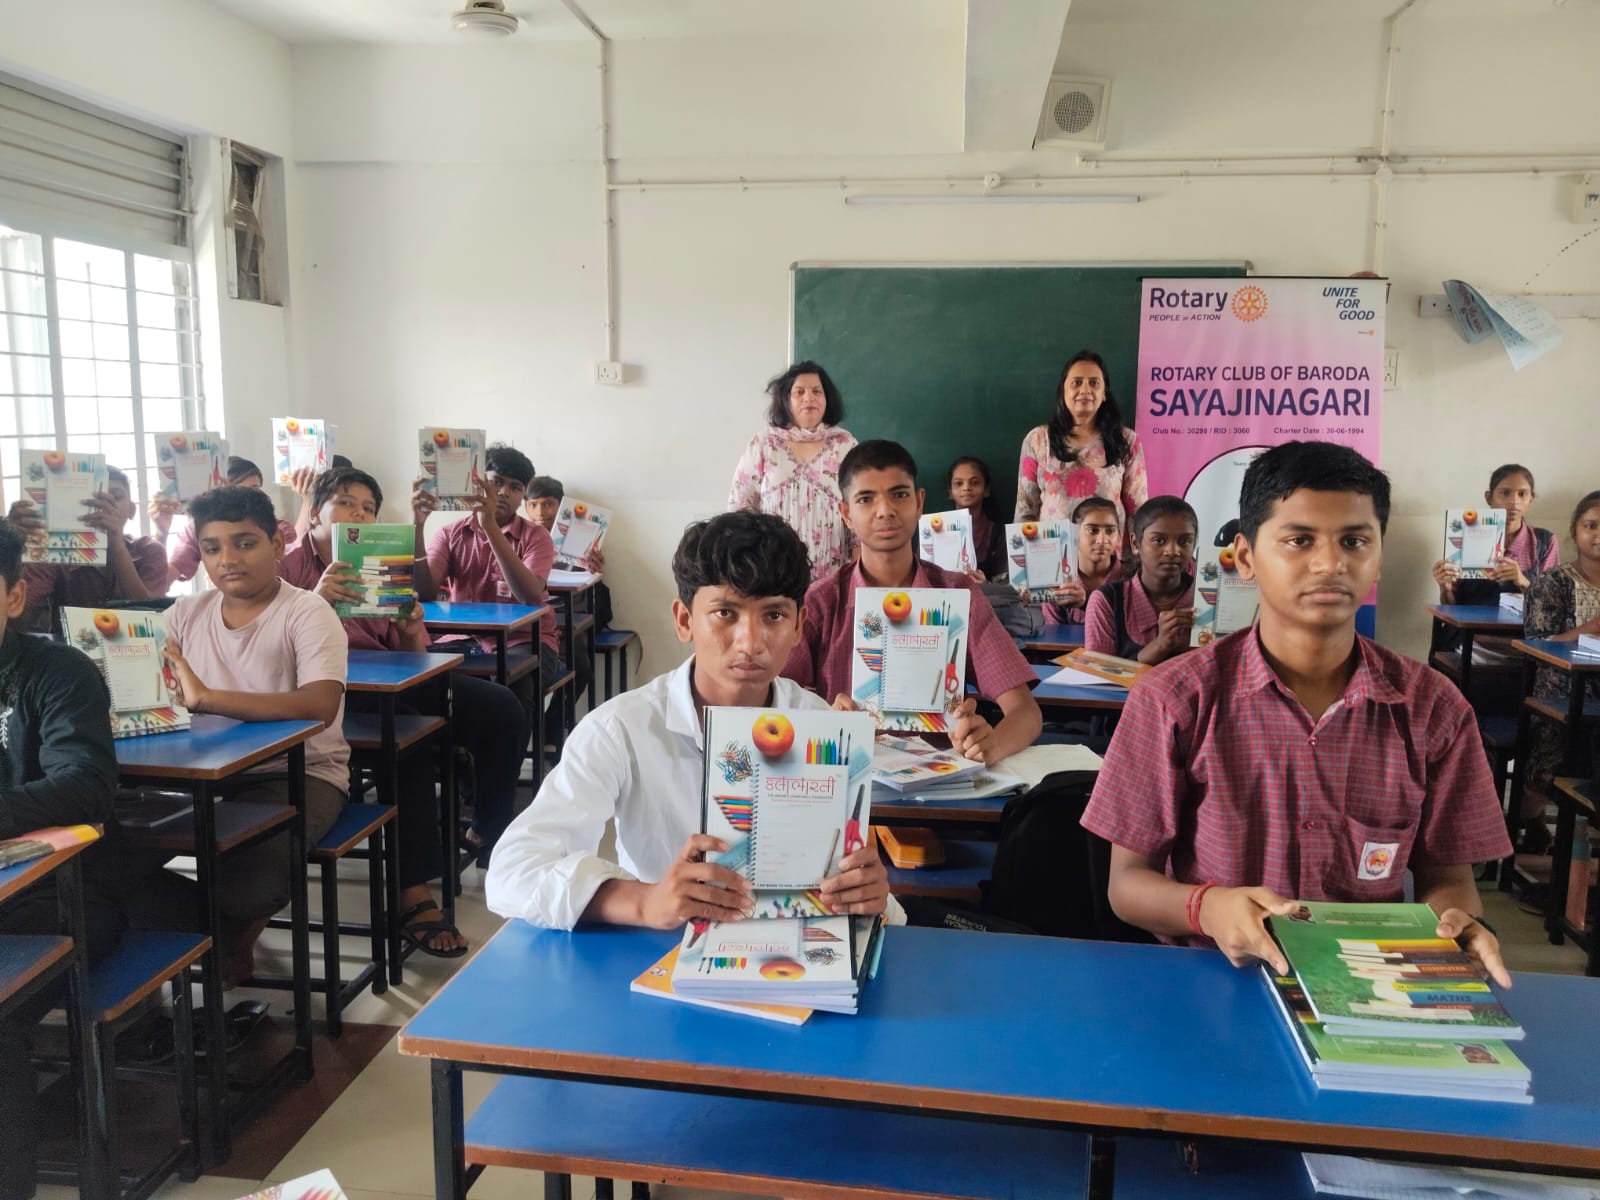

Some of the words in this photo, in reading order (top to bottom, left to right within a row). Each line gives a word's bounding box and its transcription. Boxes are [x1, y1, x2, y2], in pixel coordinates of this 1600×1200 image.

[1323, 287, 1359, 297] UNITE
[1150, 287, 1228, 312] Rotary
[1336, 298, 1360, 309] FOR
[1339, 310, 1375, 321] GOOD
[1151, 366, 1217, 382] ROTARY
[1222, 366, 1265, 381] CLUB
[1271, 366, 1293, 381] OF
[1297, 366, 1370, 381] BARODA
[1149, 388, 1370, 417] SAYAJINAGARI
